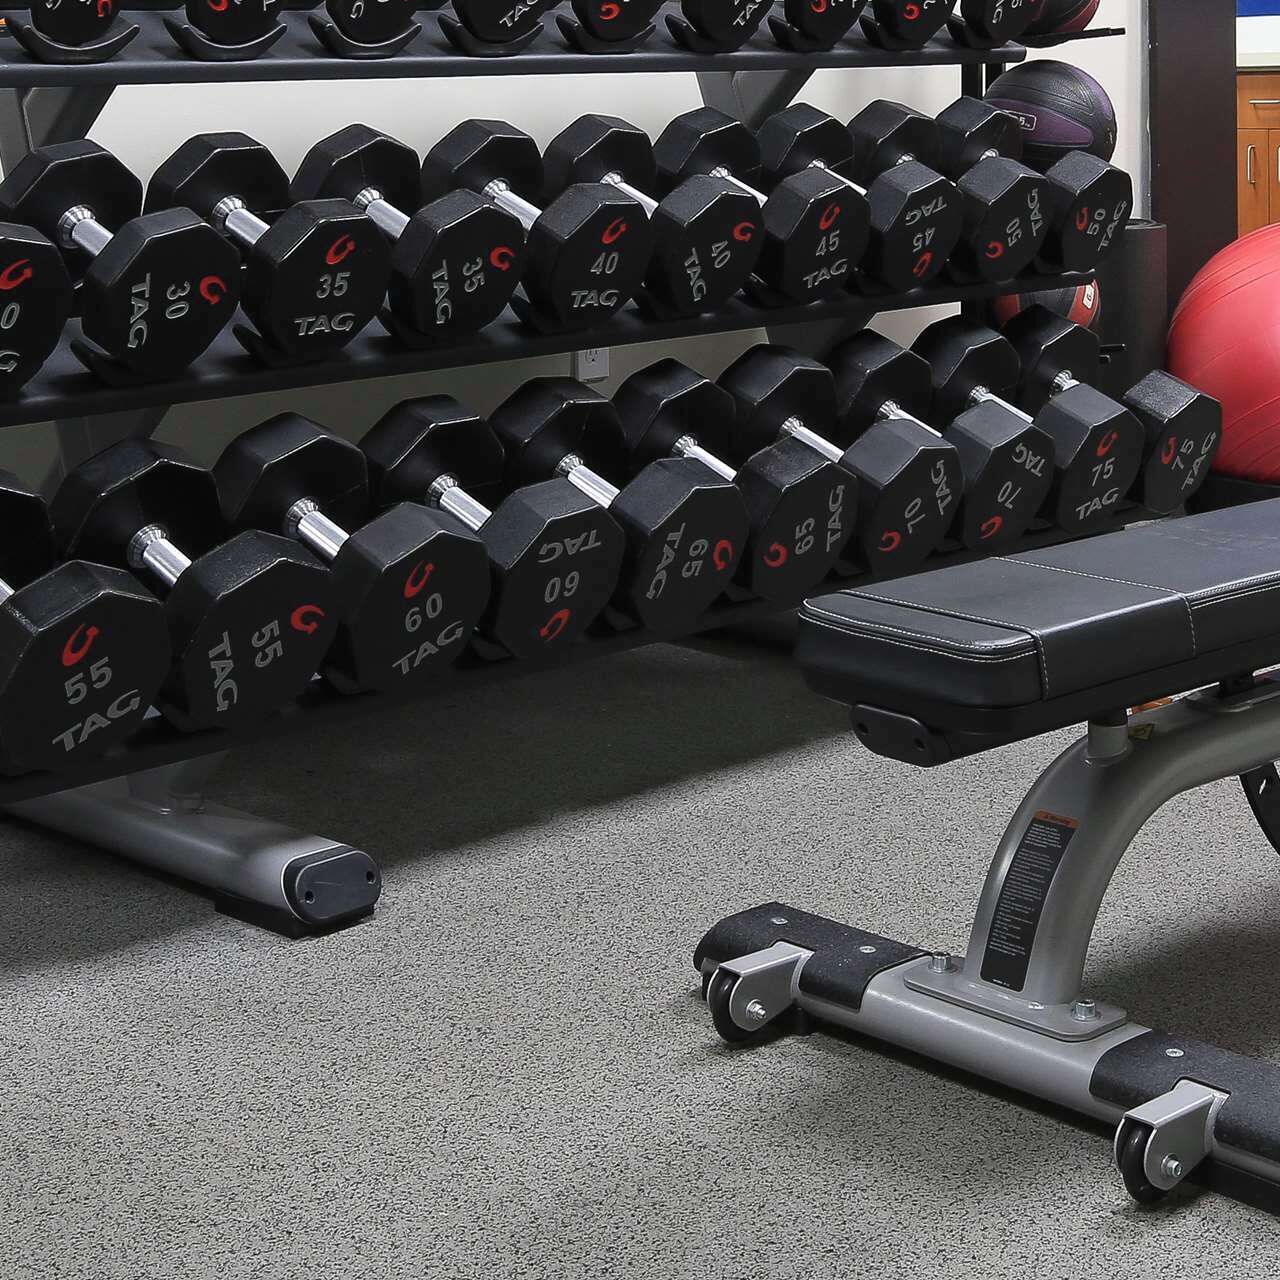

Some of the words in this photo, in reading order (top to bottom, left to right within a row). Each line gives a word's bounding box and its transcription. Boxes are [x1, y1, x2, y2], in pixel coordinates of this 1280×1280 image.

[904, 198, 948, 226] TAG
[1027, 186, 1040, 236] TAG
[1087, 207, 1107, 236] 50
[1097, 201, 1128, 250] TAG
[816, 231, 841, 257] 45
[911, 227, 935, 252] 45
[1005, 217, 1023, 248] 50
[590, 253, 620, 275] 40
[712, 240, 732, 270] 40
[316, 271, 352, 299] 35
[463, 257, 485, 294] 35
[684, 247, 708, 302] TAG
[802, 258, 849, 290] TAG
[127, 272, 152, 350] TAG
[165, 281, 192, 321] 30
[431, 260, 452, 326] TAG
[571, 287, 619, 309] TAG
[294, 313, 355, 337] TAG
[1014, 443, 1045, 478] TAG
[1092, 457, 1115, 485] 75
[1172, 441, 1194, 471] 75
[1181, 431, 1217, 491] TAG
[931, 459, 951, 515] TAG
[998, 480, 1021, 509] 70
[1075, 487, 1120, 521] TAG
[827, 485, 845, 552] TAG
[904, 497, 922, 534] 70
[537, 528, 602, 561] TAG
[795, 518, 814, 553] 65
[647, 523, 685, 600] TAG
[681, 539, 708, 578] 65
[544, 570, 580, 604] 60
[404, 593, 443, 634] 60
[252, 620, 284, 668] 55
[392, 619, 465, 675] TAG
[64, 657, 114, 704] 55
[208, 630, 238, 712] TAG
[52, 689, 142, 753] TAG
